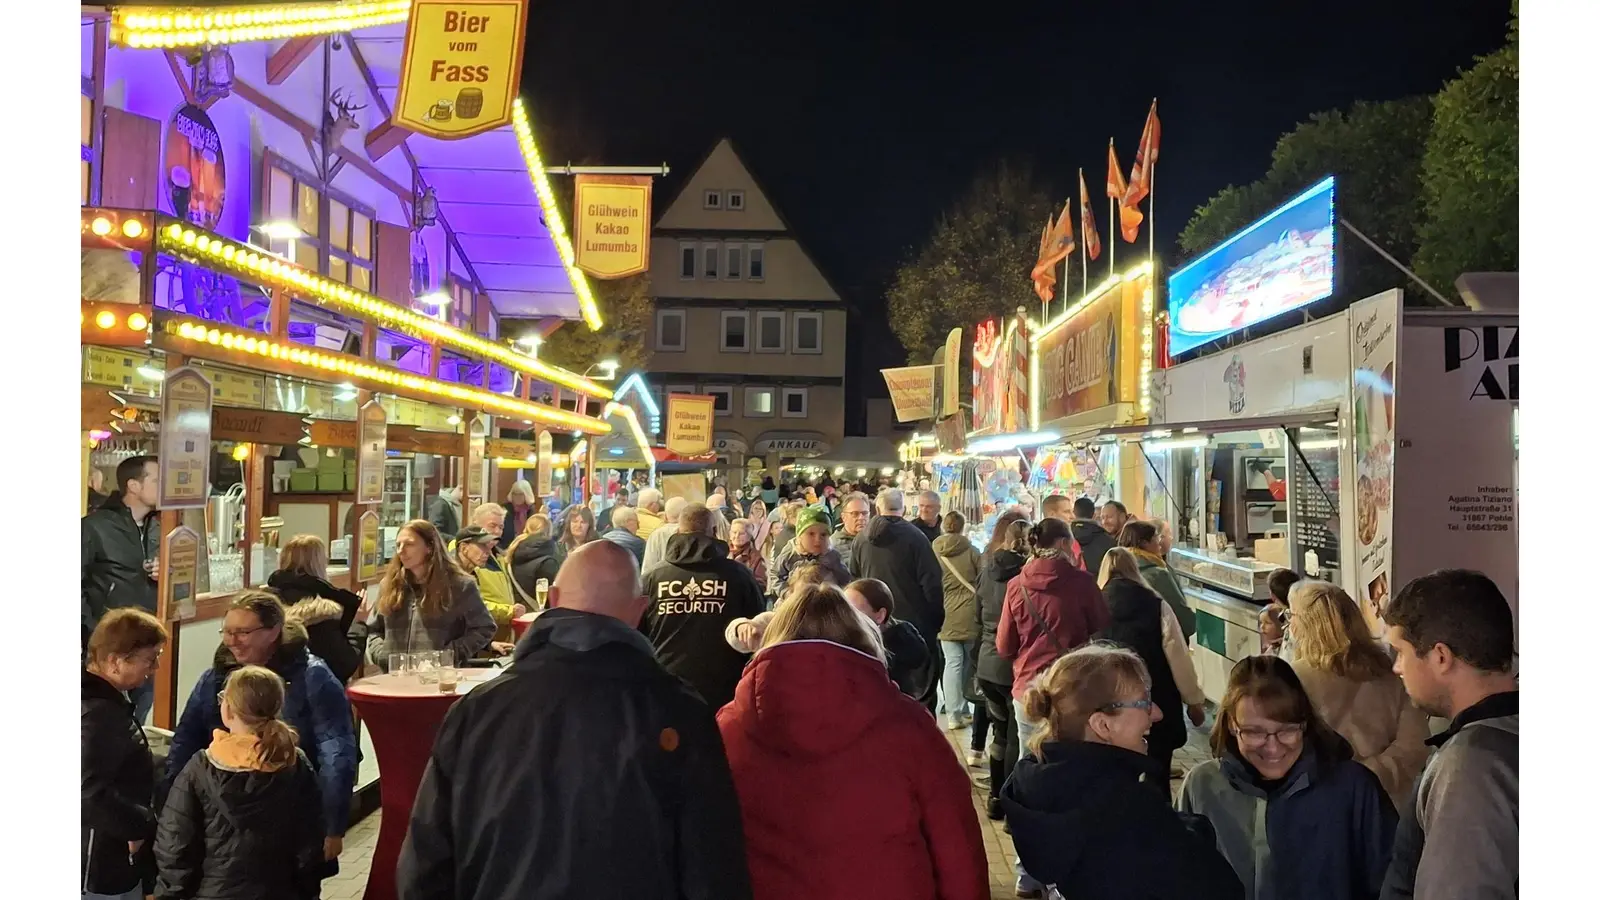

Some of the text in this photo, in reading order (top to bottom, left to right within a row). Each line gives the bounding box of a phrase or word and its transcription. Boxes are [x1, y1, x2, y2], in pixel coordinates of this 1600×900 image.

[444, 10, 490, 33] Bier
[448, 41, 478, 52] vom
[430, 59, 489, 82] Fass
[588, 203, 638, 218] Glühwein
[595, 222, 629, 235] Kakao
[586, 239, 638, 253] Lumumba
[679, 423, 701, 432] Kakao
[768, 440, 818, 450] ANKAUF
[1483, 495, 1513, 503] Tiziano
[1449, 505, 1501, 513] Hauptstraße
[657, 601, 726, 616] SECURITY
